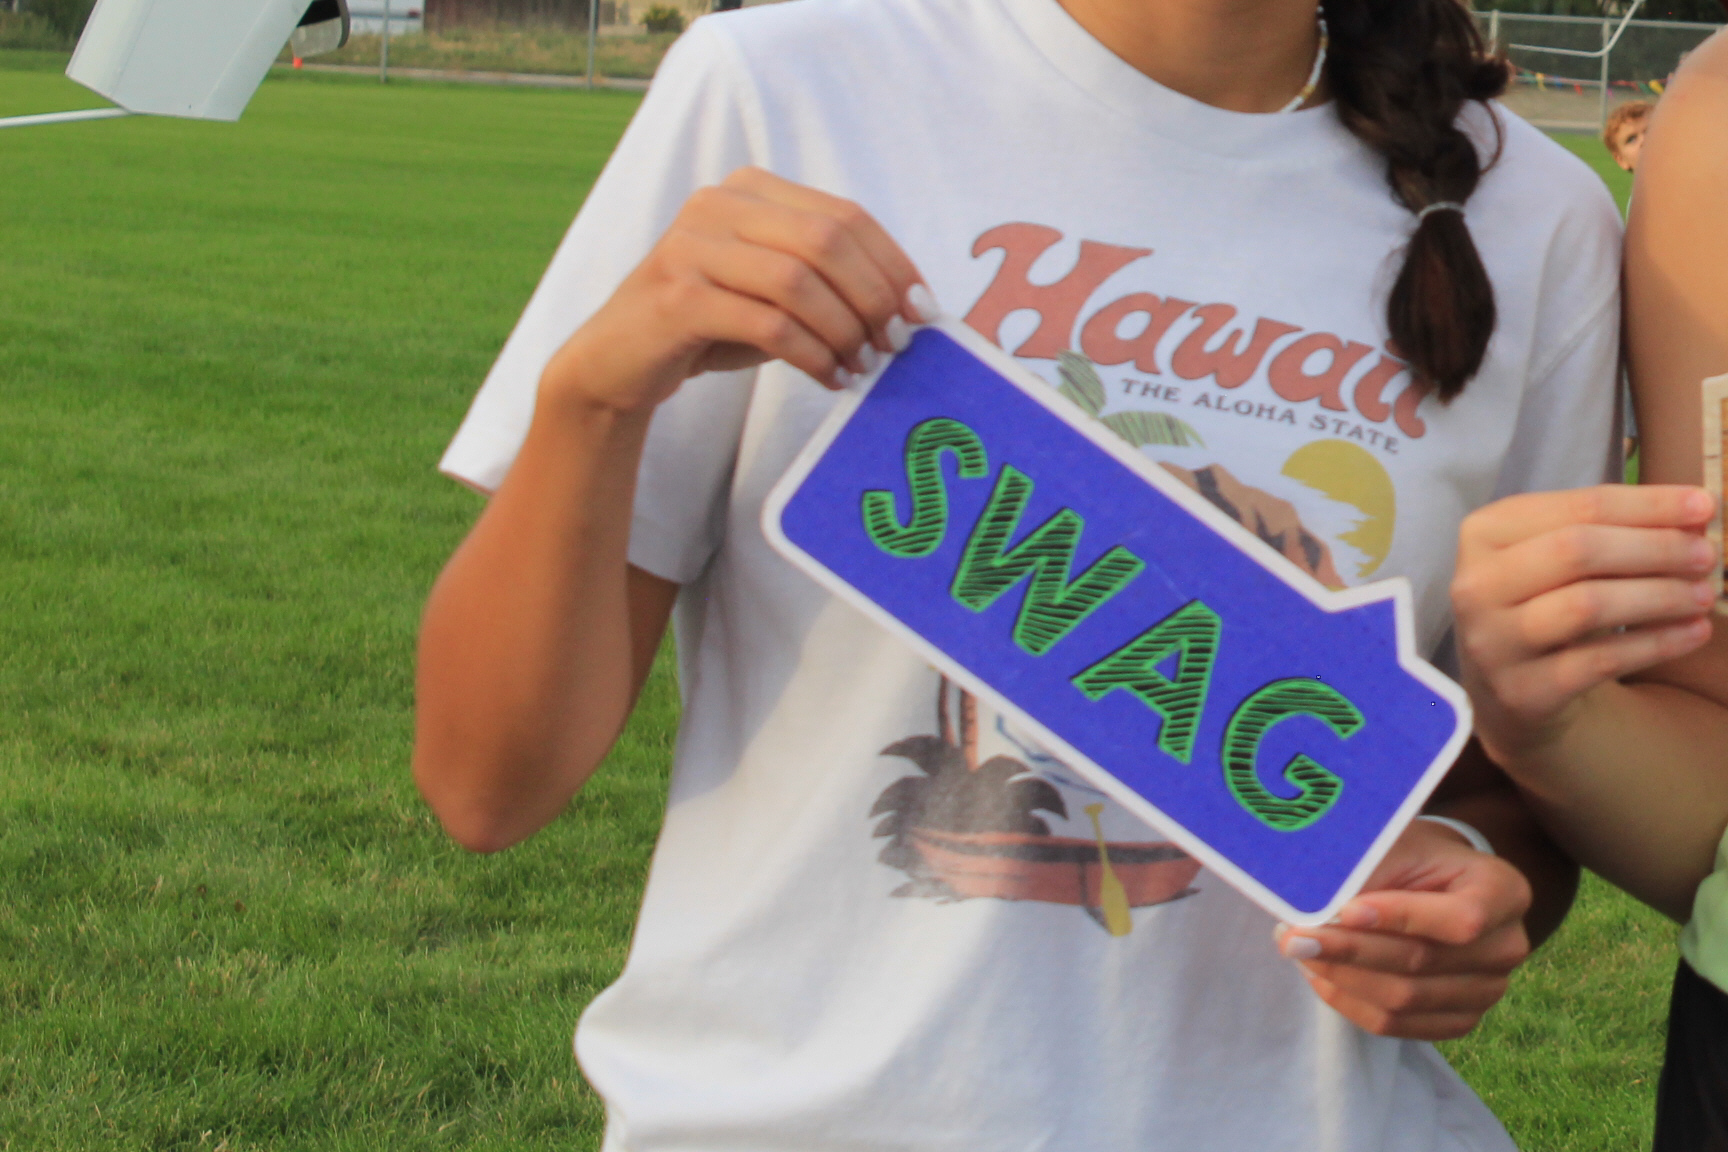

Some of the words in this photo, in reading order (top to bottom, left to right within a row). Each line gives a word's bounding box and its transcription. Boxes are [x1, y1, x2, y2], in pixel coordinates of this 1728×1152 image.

[1121, 378, 1180, 403] THE
[1193, 392, 1297, 425] ALOHA
[1309, 414, 1399, 455] STATE
[861, 416, 1366, 833] SWAG
